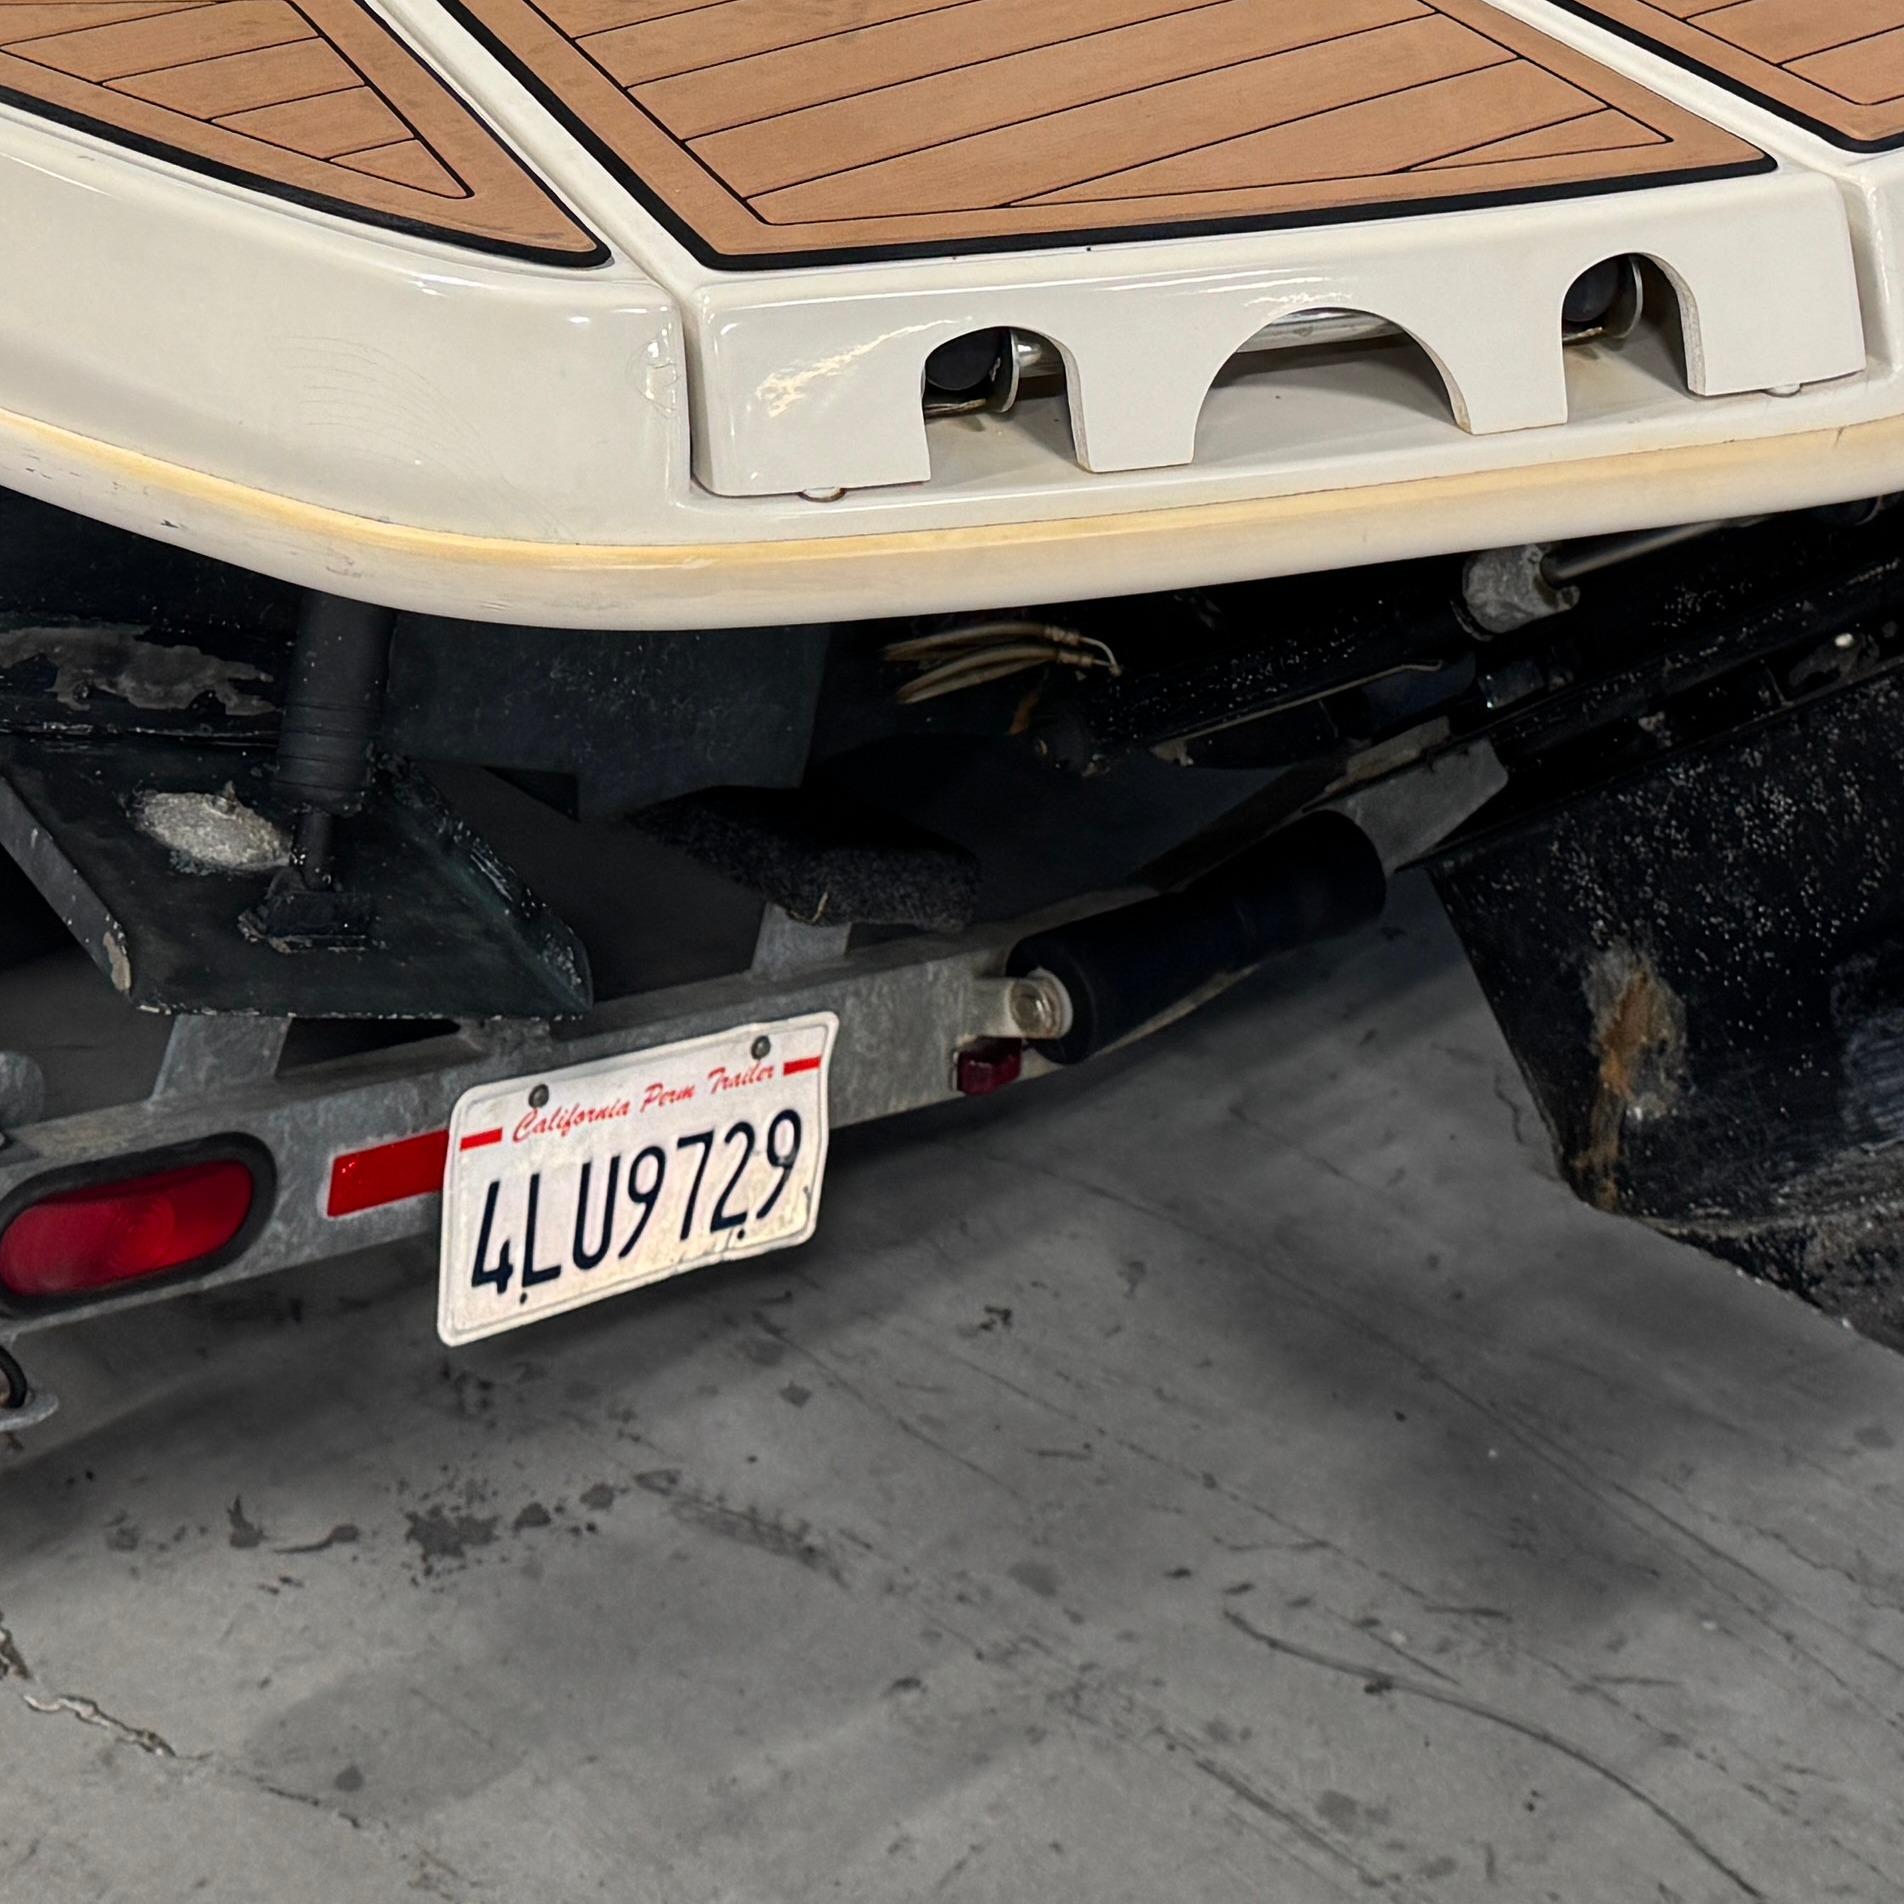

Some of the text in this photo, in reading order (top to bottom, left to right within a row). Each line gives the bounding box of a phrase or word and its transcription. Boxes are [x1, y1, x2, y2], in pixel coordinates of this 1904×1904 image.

[512, 1061, 776, 1144] California Perm Trailer
[471, 1108, 802, 1295] 4LU9729
